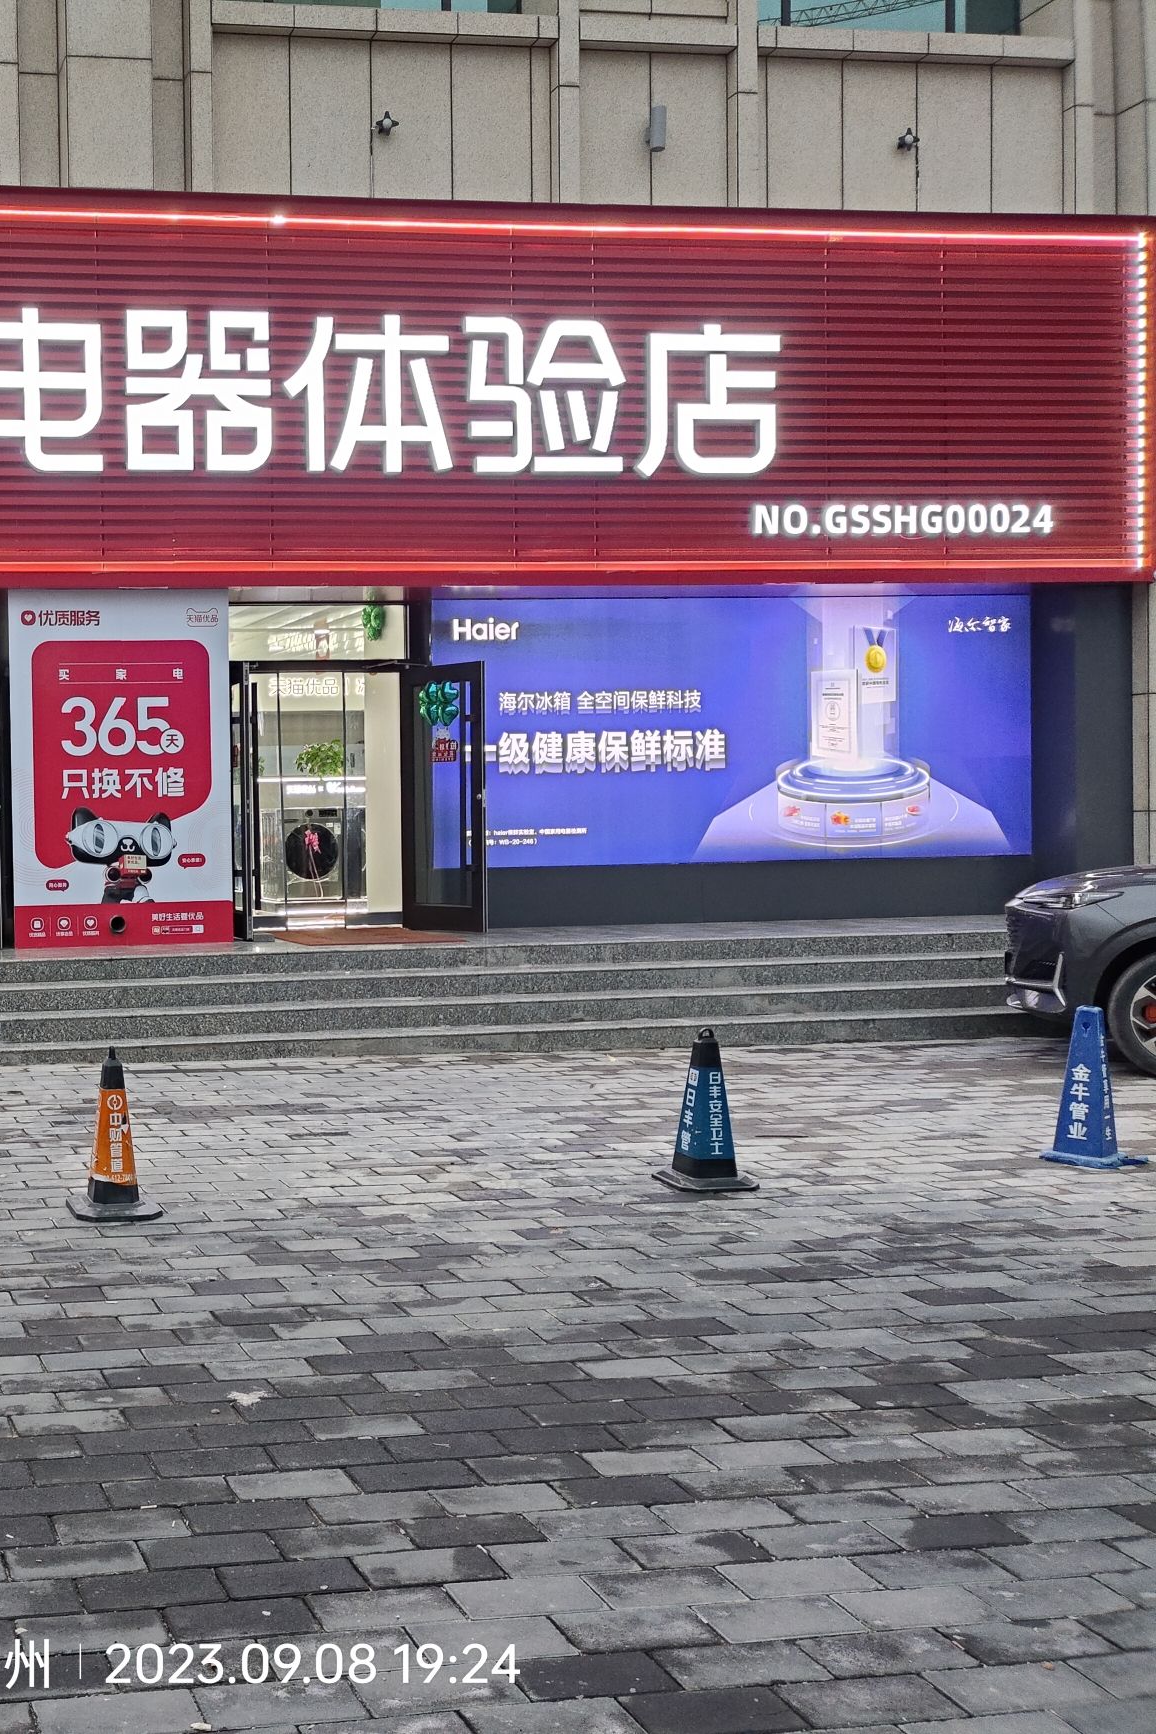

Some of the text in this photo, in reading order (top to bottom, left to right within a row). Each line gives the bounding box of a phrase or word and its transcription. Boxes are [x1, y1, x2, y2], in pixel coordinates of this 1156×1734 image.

[753, 503, 1055, 535] NO.GSSHG00024
[38, 610, 101, 626] 优质服务
[186, 614, 219, 624] 天猫优品
[452, 617, 520, 641] Haier
[268, 677, 340, 696] 天猫优品
[498, 689, 702, 711] 海尔冰箱 全空间保鲜科技
[60, 696, 172, 757] 365
[61, 768, 185, 799] 只换不修
[708, 1071, 724, 1155] 日丰安全卫士
[1067, 1063, 1092, 1141] 金牛管业
[681, 1088, 695, 1151] 日丰管
[109, 1112, 124, 1173] 中财管道
